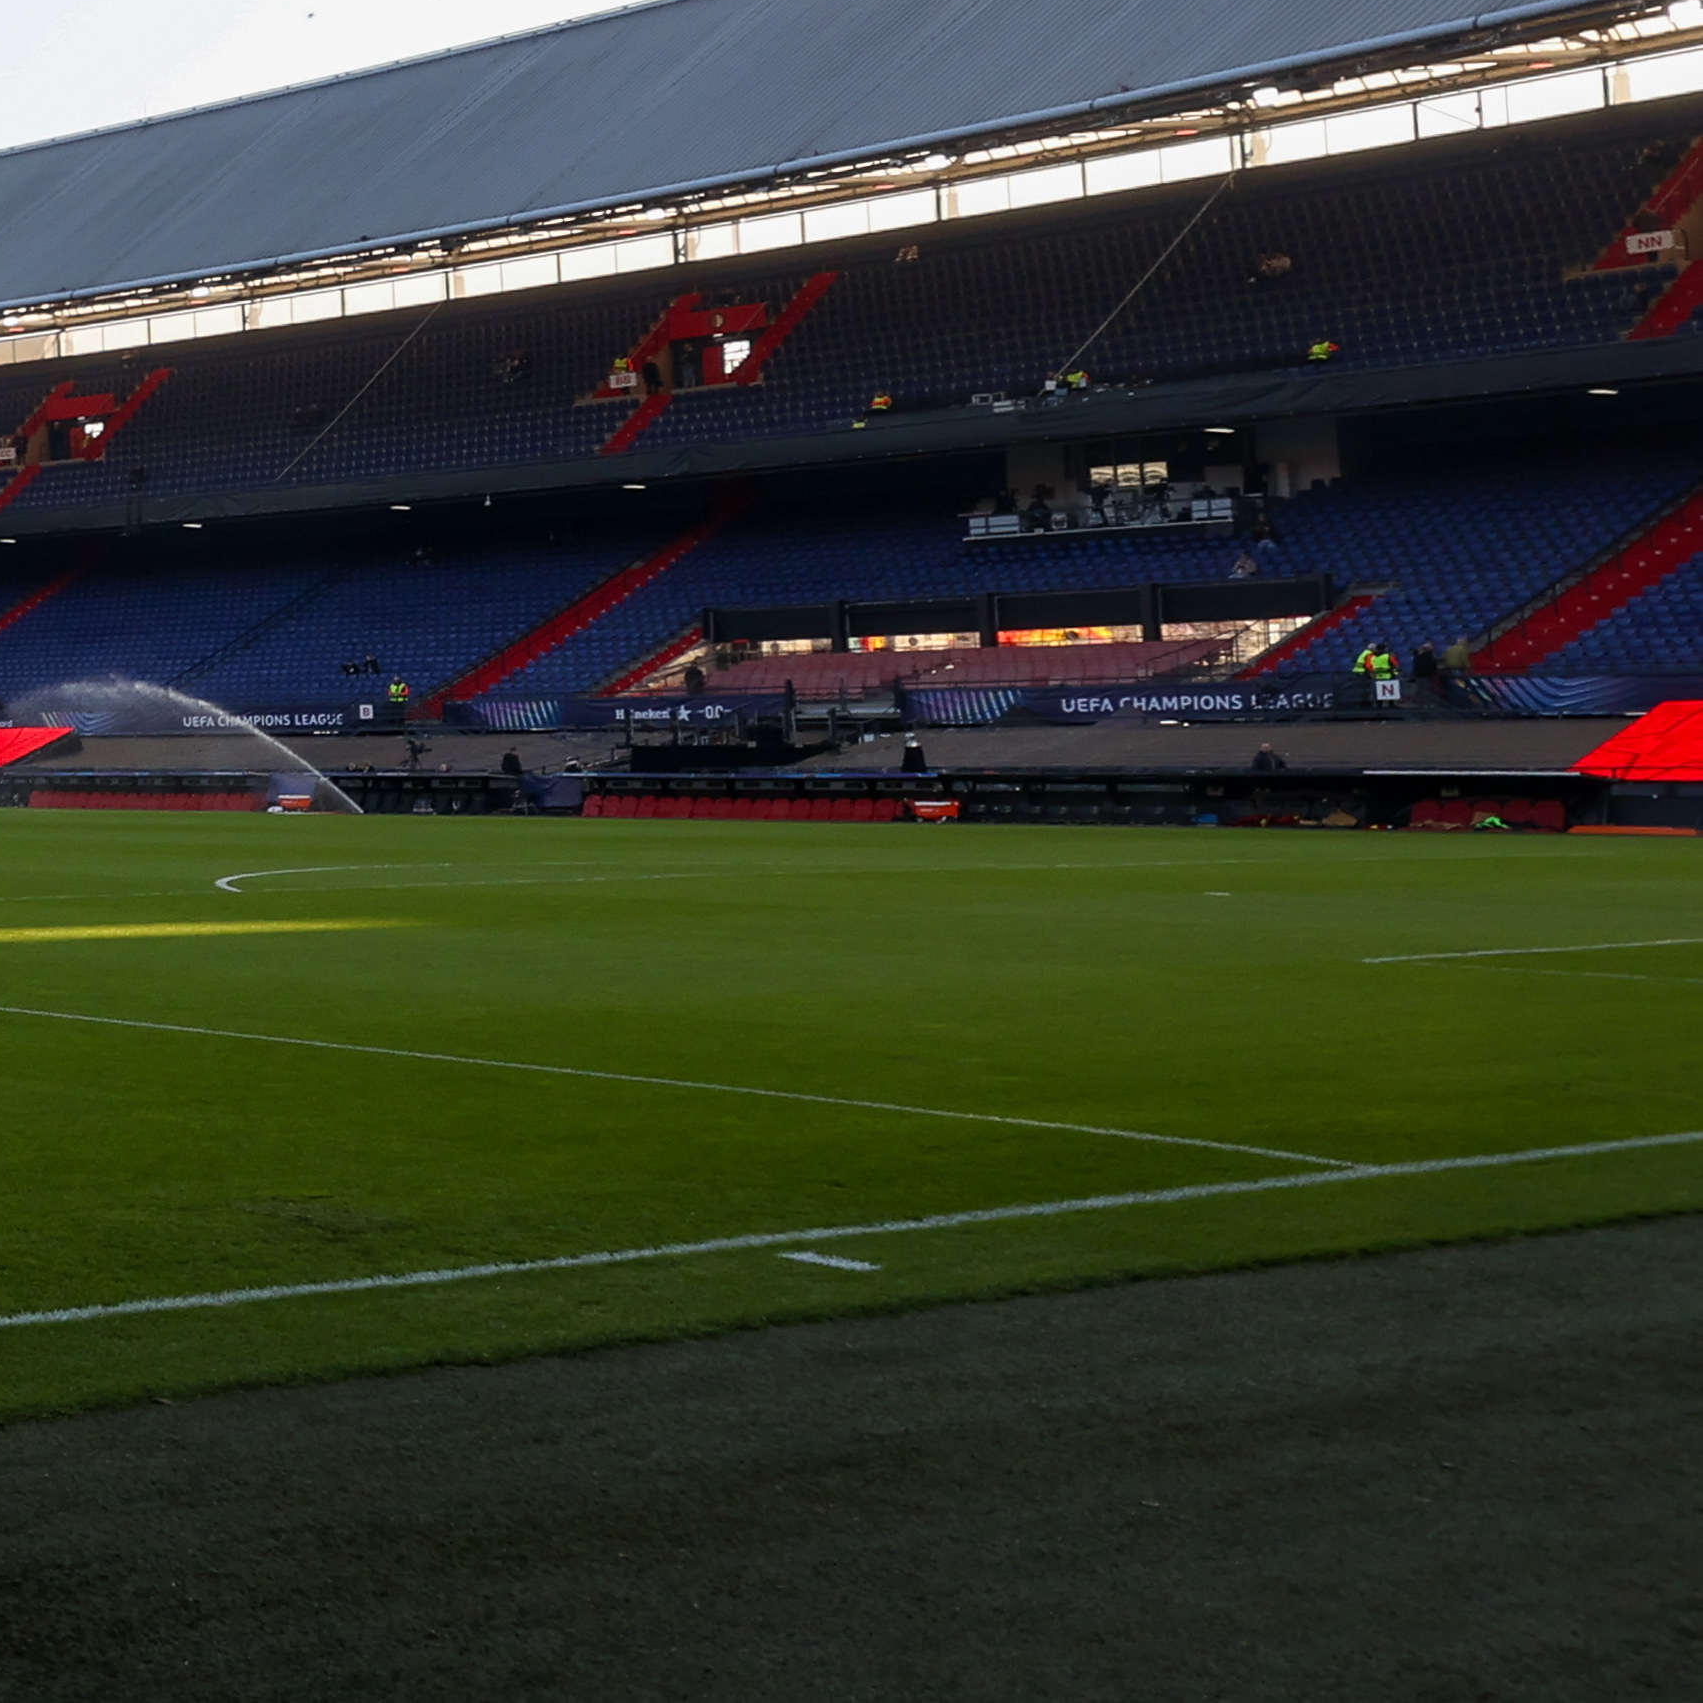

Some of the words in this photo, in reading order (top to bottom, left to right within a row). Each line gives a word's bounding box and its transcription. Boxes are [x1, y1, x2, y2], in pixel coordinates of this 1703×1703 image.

[1638, 236, 1662, 249] NN
[1381, 683, 1394, 697] N
[1061, 697, 1114, 713] UEFA
[183, 715, 215, 727] UEFA
[218, 714, 290, 727] CHAMPIONS
[294, 713, 343, 725] LEAGUE
[615, 708, 671, 719] Hneken
